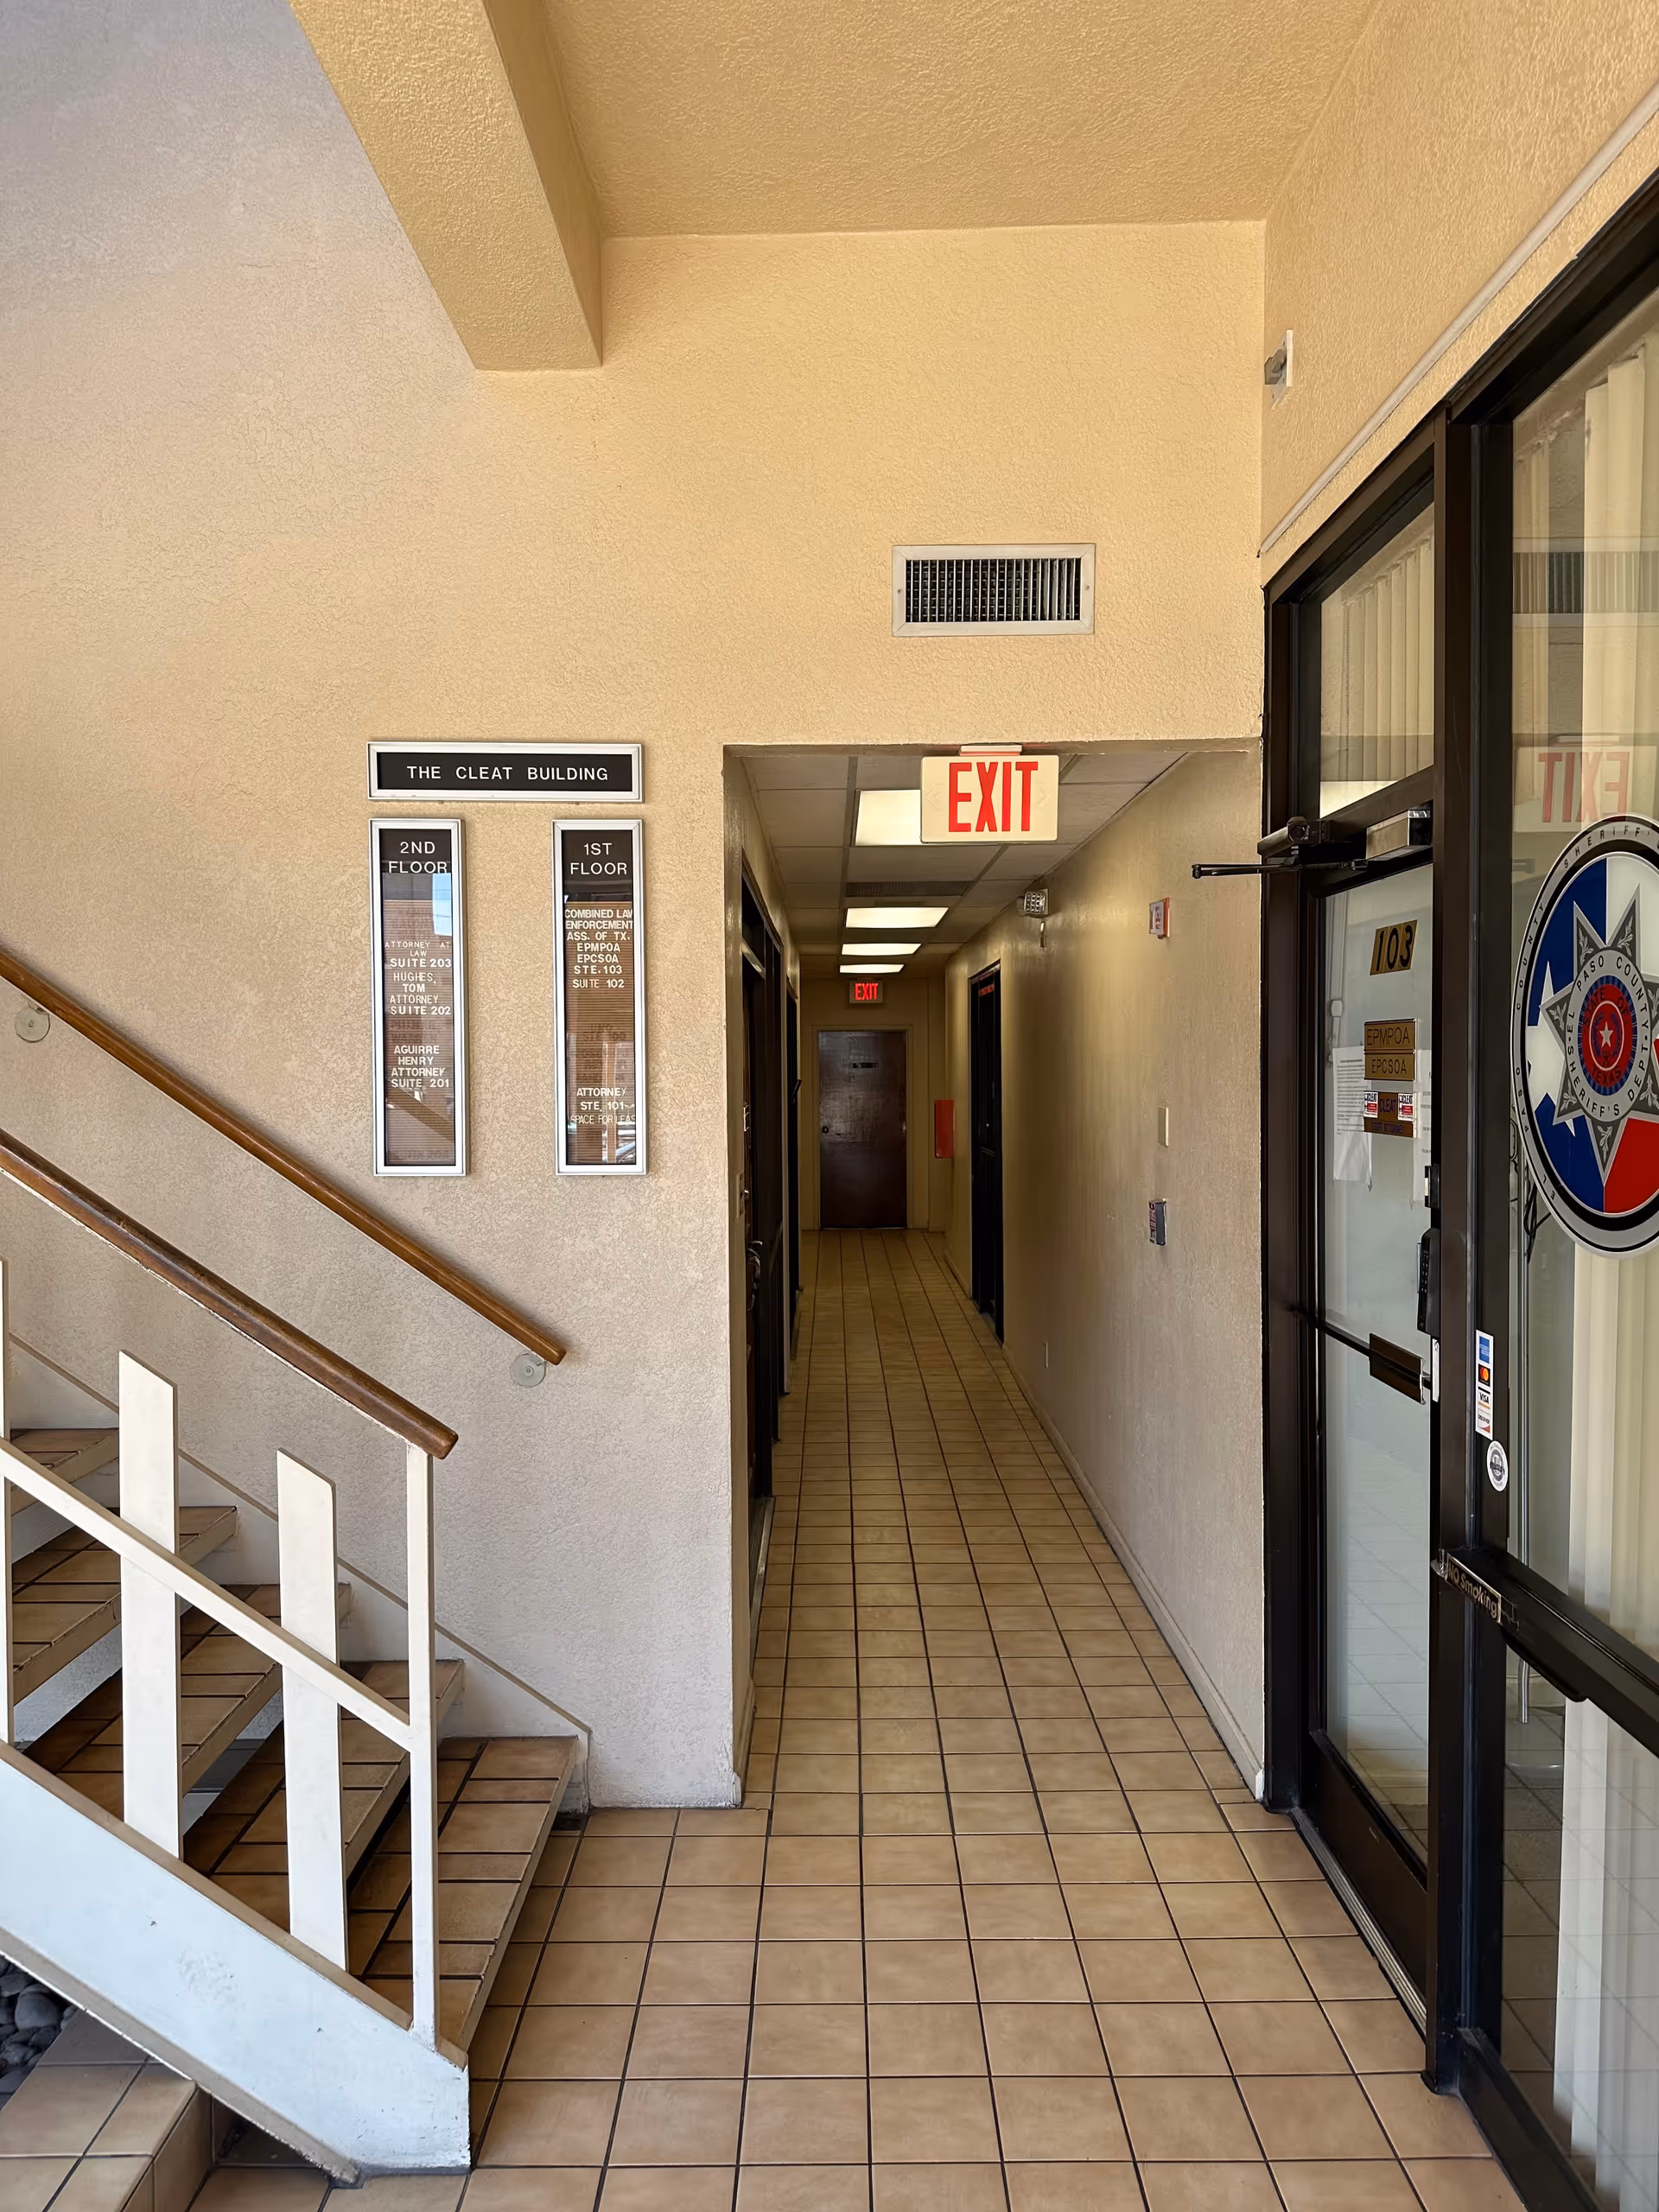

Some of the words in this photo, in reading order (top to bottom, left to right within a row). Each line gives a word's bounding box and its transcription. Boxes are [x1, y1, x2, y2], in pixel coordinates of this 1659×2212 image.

[407, 766, 442, 779] THE
[455, 766, 513, 780] CLEAT
[527, 766, 608, 781] BUILDING
[949, 761, 1038, 832] EXIT
[400, 842, 435, 855] 2ND
[583, 842, 613, 855] 1ST
[1564, 825, 1659, 869] SHERIFF'
[389, 861, 448, 874] FLOOR
[570, 862, 627, 875] FLOOR
[564, 909, 613, 918] COMBINED
[565, 920, 633, 930] ENFORCEMENT
[567, 931, 590, 941] ASS.
[594, 931, 607, 941] OF
[613, 931, 631, 941] TX.
[576, 943, 621, 952] EPMPOA
[1376, 924, 1414, 972] 103
[390, 958, 427, 968] SUITE
[429, 958, 451, 968] 203
[577, 954, 620, 963] EPCSOA
[393, 972, 436, 985] HUGHES,
[572, 979, 600, 988] SUITE
[607, 979, 625, 988] 102
[402, 983, 426, 993] TOM
[855, 982, 879, 1001] EXIT
[390, 995, 439, 1004] ATTORNEY
[1567, 1011, 1575, 1033] EL
[1576, 955, 1605, 992] PASO
[1616, 957, 1649, 1028] COUNTY
[391, 1006, 427, 1015] SUITE
[431, 1006, 451, 1015] 202
[1367, 1027, 1410, 1046] EPMPOA
[393, 1045, 440, 1054] AGUIRRE
[397, 1056, 434, 1065] HENRY
[1371, 1058, 1407, 1074] EPCSOA
[391, 1067, 446, 1077] ATTORNEY
[391, 1078, 423, 1088] SUITE
[429, 1078, 449, 1088] 201
[1567, 1046, 1620, 1117] SHERIFF'S
[576, 1087, 627, 1096] ATTORNEY
[580, 1101, 602, 1112] STE.
[607, 1101, 624, 1110] 101
[570, 1115, 594, 1124] SPACE
[598, 1115, 613, 1124] FOR
[1479, 1392, 1489, 1404] VISA
[1460, 1573, 1497, 1618] Smoking
